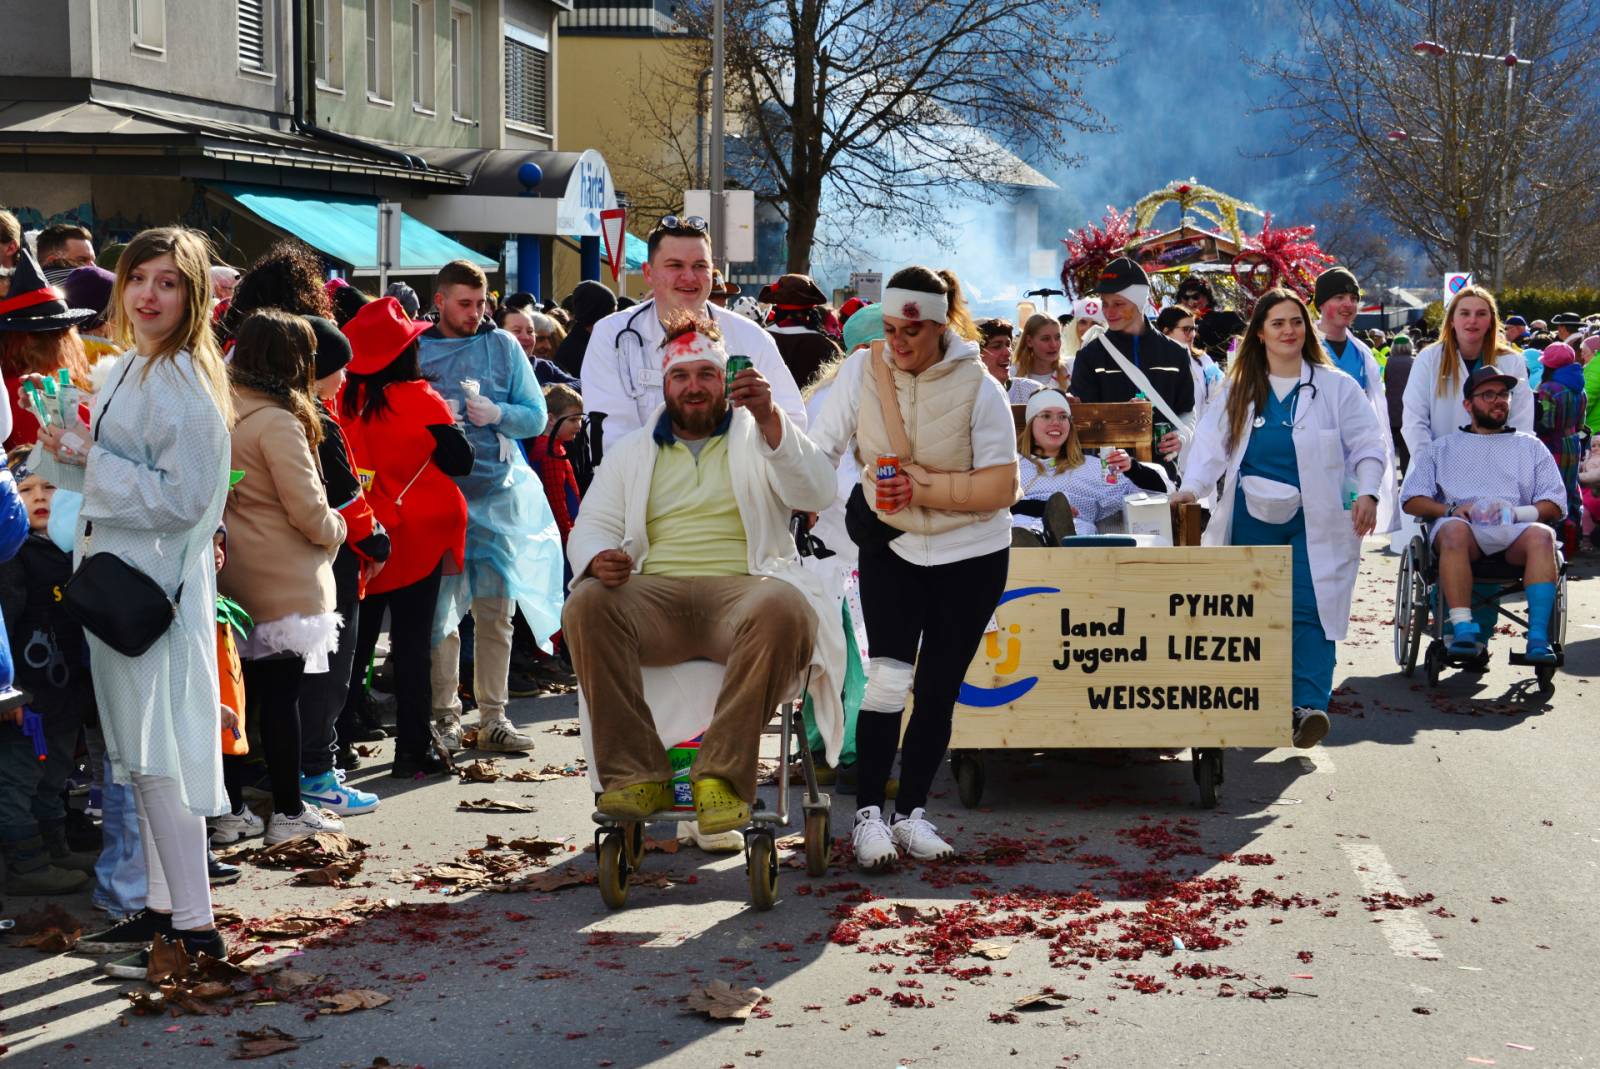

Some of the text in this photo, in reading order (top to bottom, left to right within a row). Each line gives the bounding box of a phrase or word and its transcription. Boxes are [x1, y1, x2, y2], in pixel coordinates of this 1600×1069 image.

[1169, 593, 1254, 617] PYHRN
[1060, 607, 1126, 637] land
[1052, 635, 1148, 674] jugend
[1167, 634, 1261, 662] LIEZEN
[1087, 684, 1260, 711] WEISSENBACH
